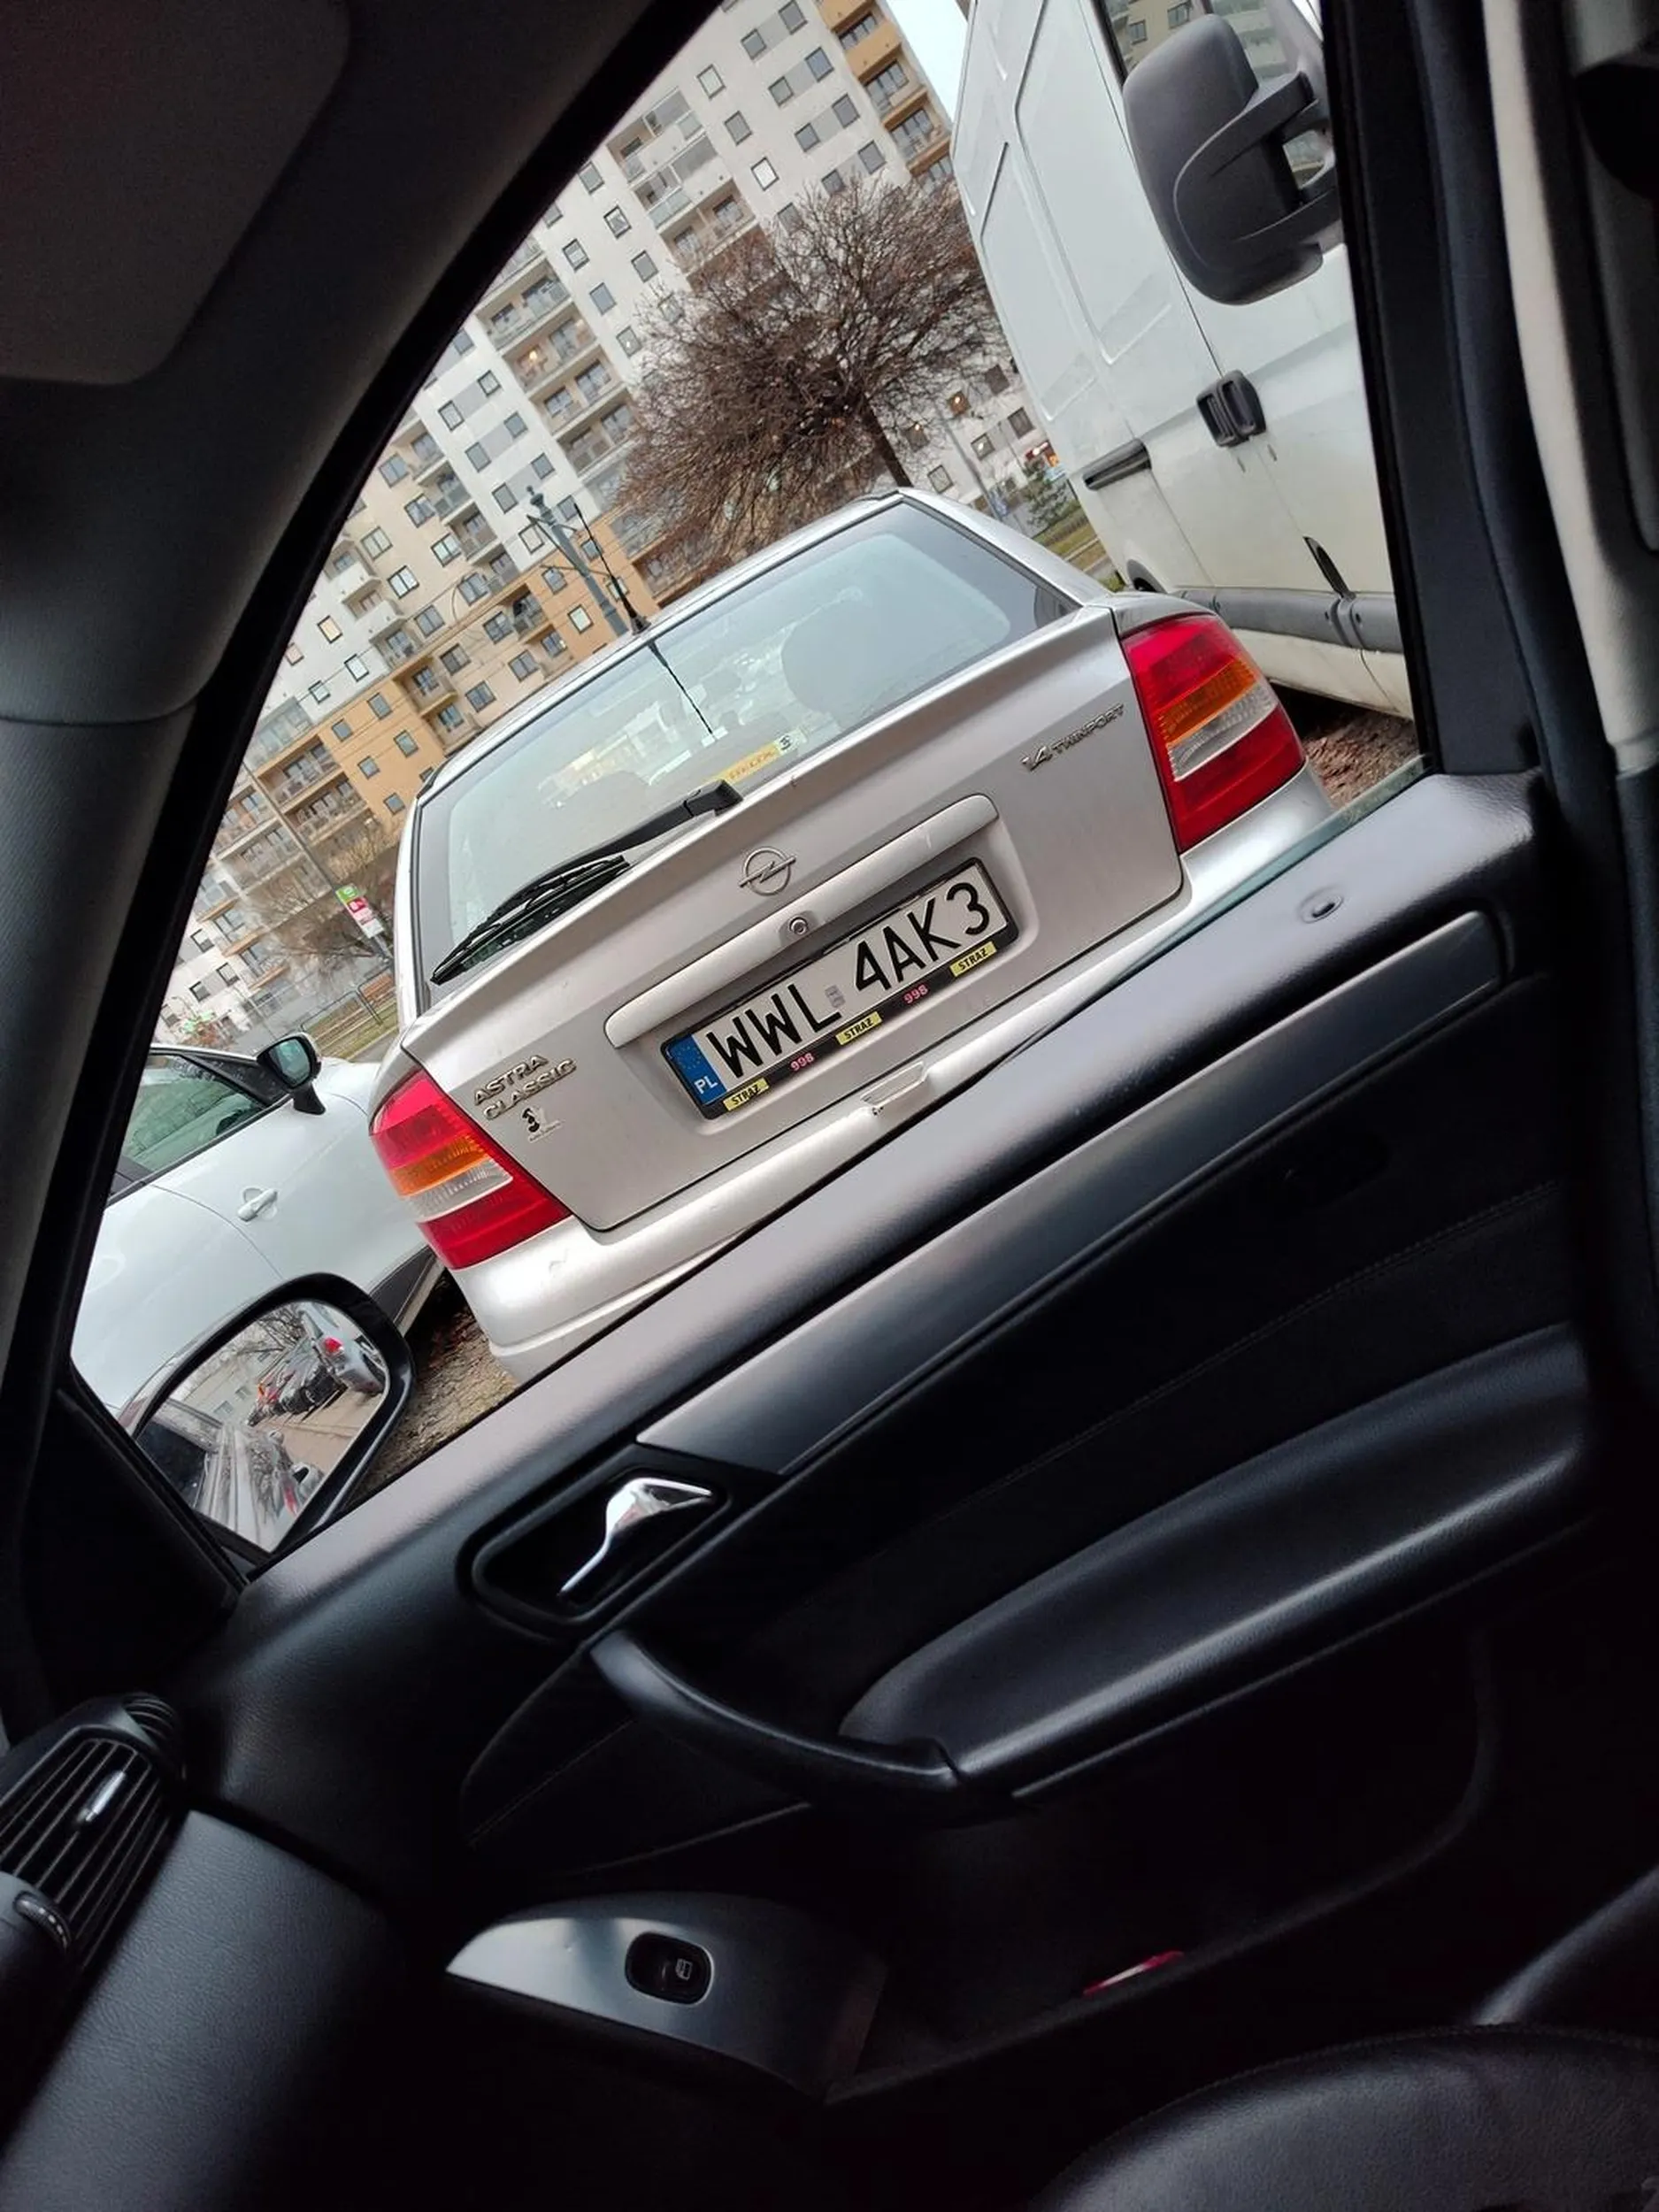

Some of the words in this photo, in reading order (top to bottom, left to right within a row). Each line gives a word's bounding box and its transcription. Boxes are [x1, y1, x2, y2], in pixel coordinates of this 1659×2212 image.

[706, 984, 841, 1079] WWL
[855, 882, 991, 991] 4AK3
[790, 1052, 814, 1071] 998
[903, 984, 928, 1003] 998
[474, 1055, 549, 1105] ASTRA
[484, 1058, 577, 1120] CLASSIC
[694, 1075, 718, 1094] PL
